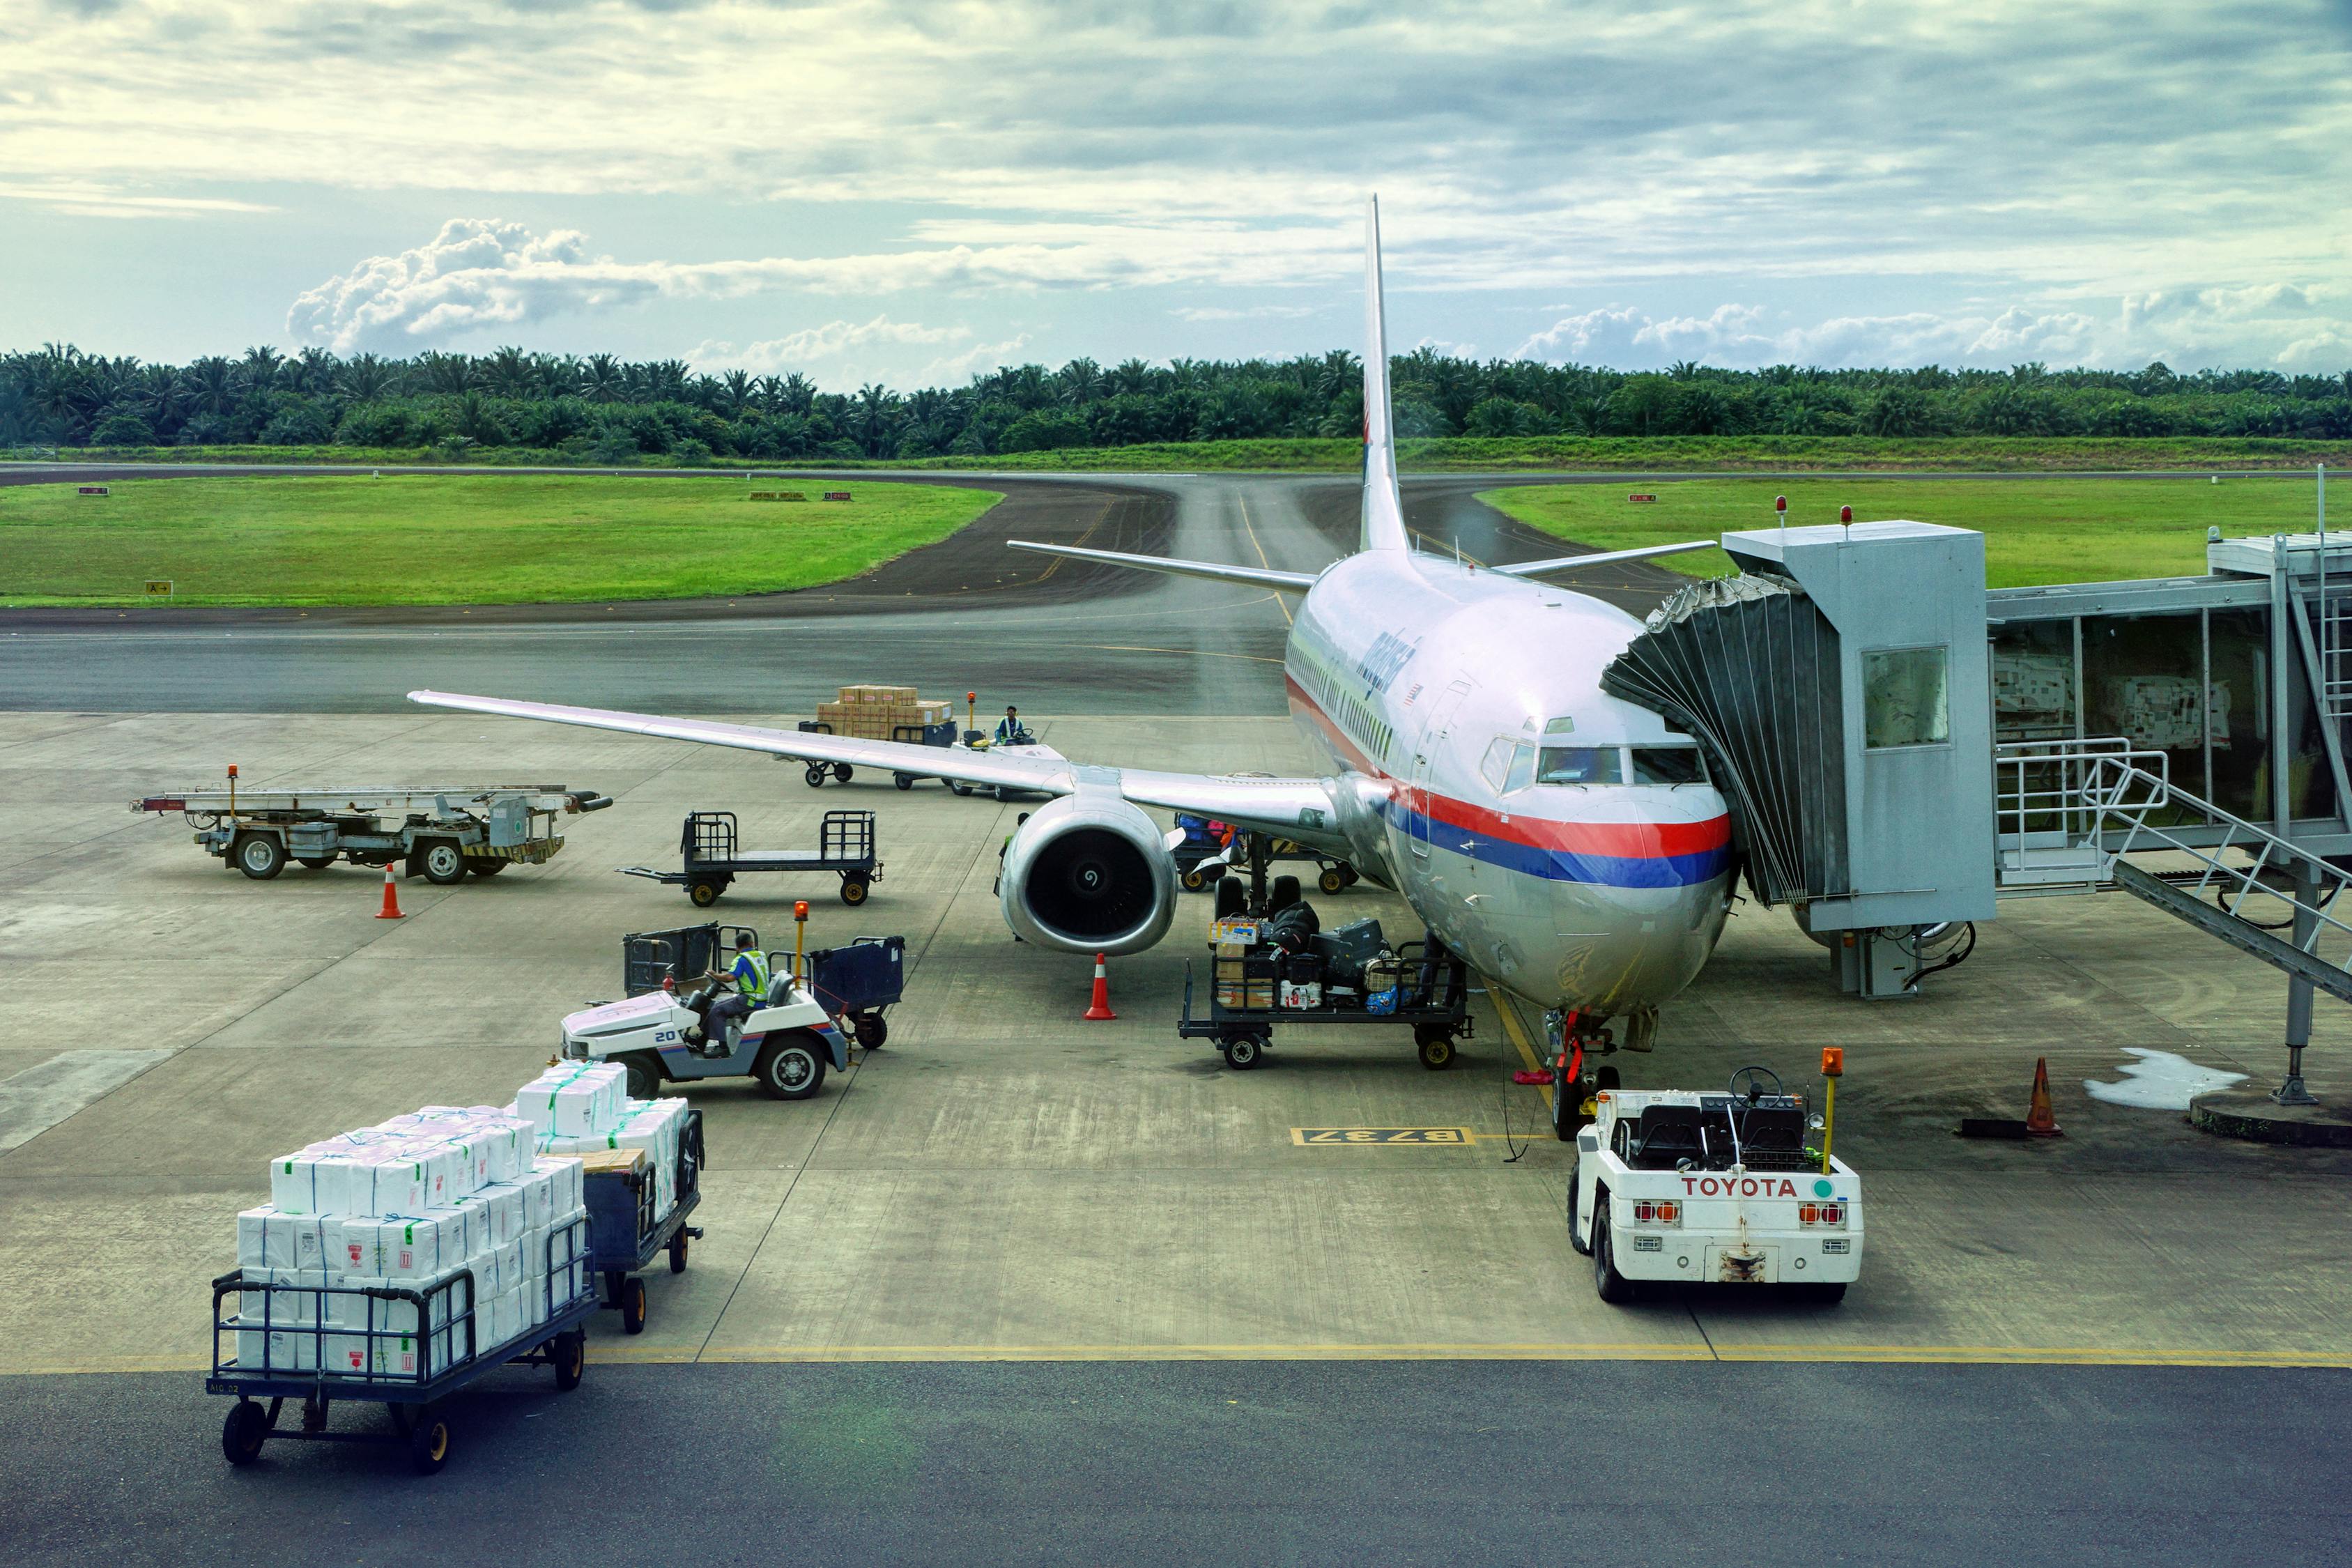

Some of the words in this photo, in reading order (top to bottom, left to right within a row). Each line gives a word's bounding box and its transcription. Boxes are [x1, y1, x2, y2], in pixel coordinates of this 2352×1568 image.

[655, 1030, 676, 1043] 20
[1309, 1130, 1460, 1142] B737
[1681, 1177, 1797, 1197] TOYOTA
